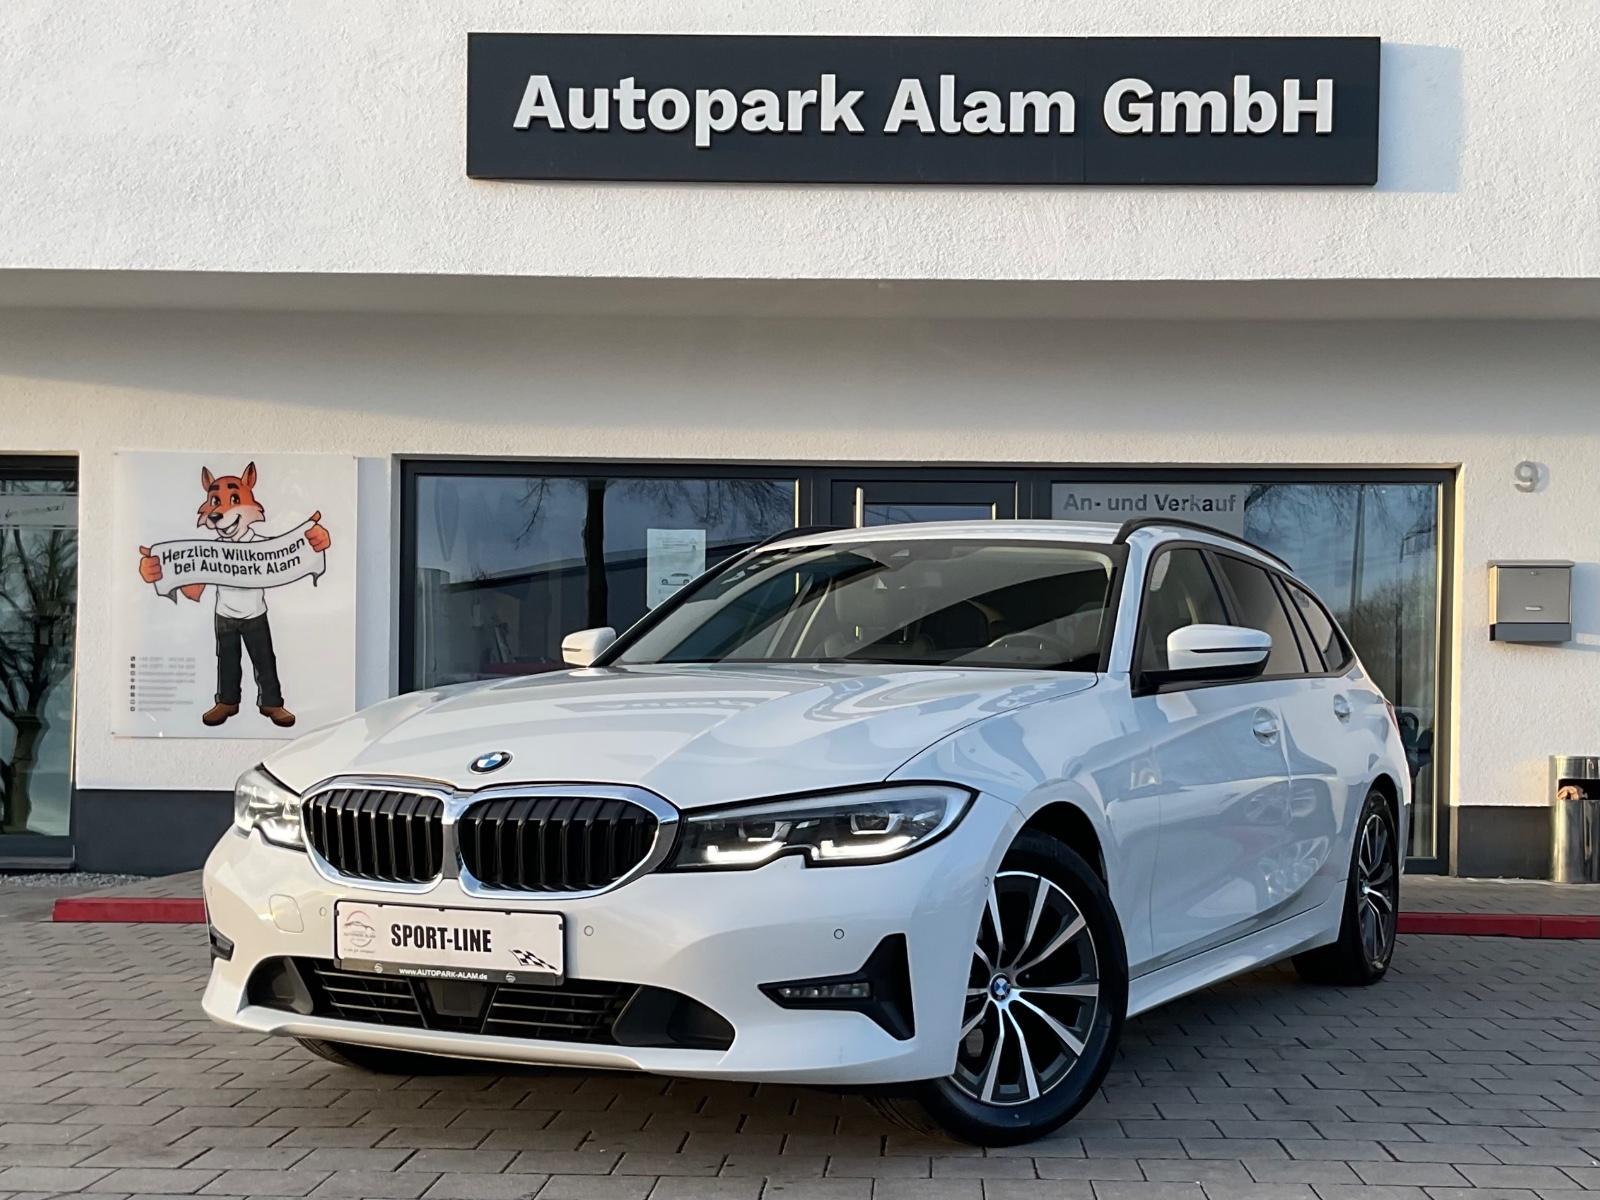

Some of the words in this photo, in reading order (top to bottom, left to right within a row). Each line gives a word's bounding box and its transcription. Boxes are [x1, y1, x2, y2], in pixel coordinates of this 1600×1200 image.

[512, 73, 865, 148] Autopark
[883, 73, 1076, 135] Alam
[1102, 74, 1334, 135] GmbH
[1513, 460, 1540, 494] 9
[1063, 493, 1102, 512] An-
[1107, 493, 1148, 512] und
[1154, 493, 1237, 513] Verkauf
[162, 545, 219, 566] Herzlich
[221, 537, 306, 562] Willkommen
[174, 558, 197, 576] bei
[200, 558, 263, 577] Autopark
[265, 556, 301, 576] Alam
[390, 922, 493, 953] SPORT-LINE
[399, 967, 489, 981] www.AUTOPARK-ALAM.de
